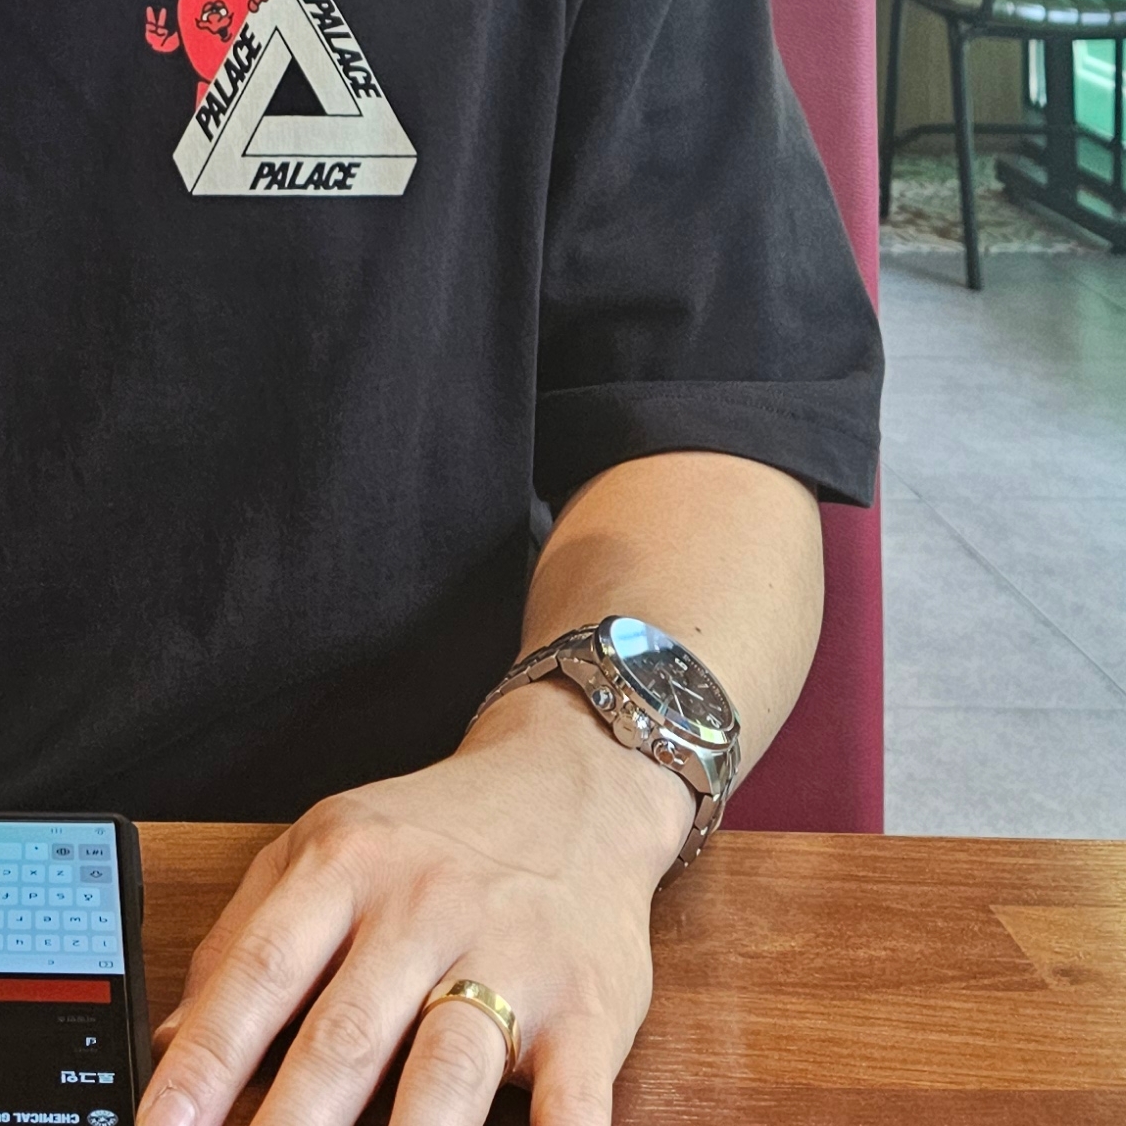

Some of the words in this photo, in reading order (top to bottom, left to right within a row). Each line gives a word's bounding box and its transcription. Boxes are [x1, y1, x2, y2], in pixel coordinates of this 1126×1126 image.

[195, 22, 263, 142] PALACE
[249, 161, 361, 191] PALACE
[60, 1070, 116, 1084] 로그인
[13, 1112, 80, 1124] CHEMICAL
